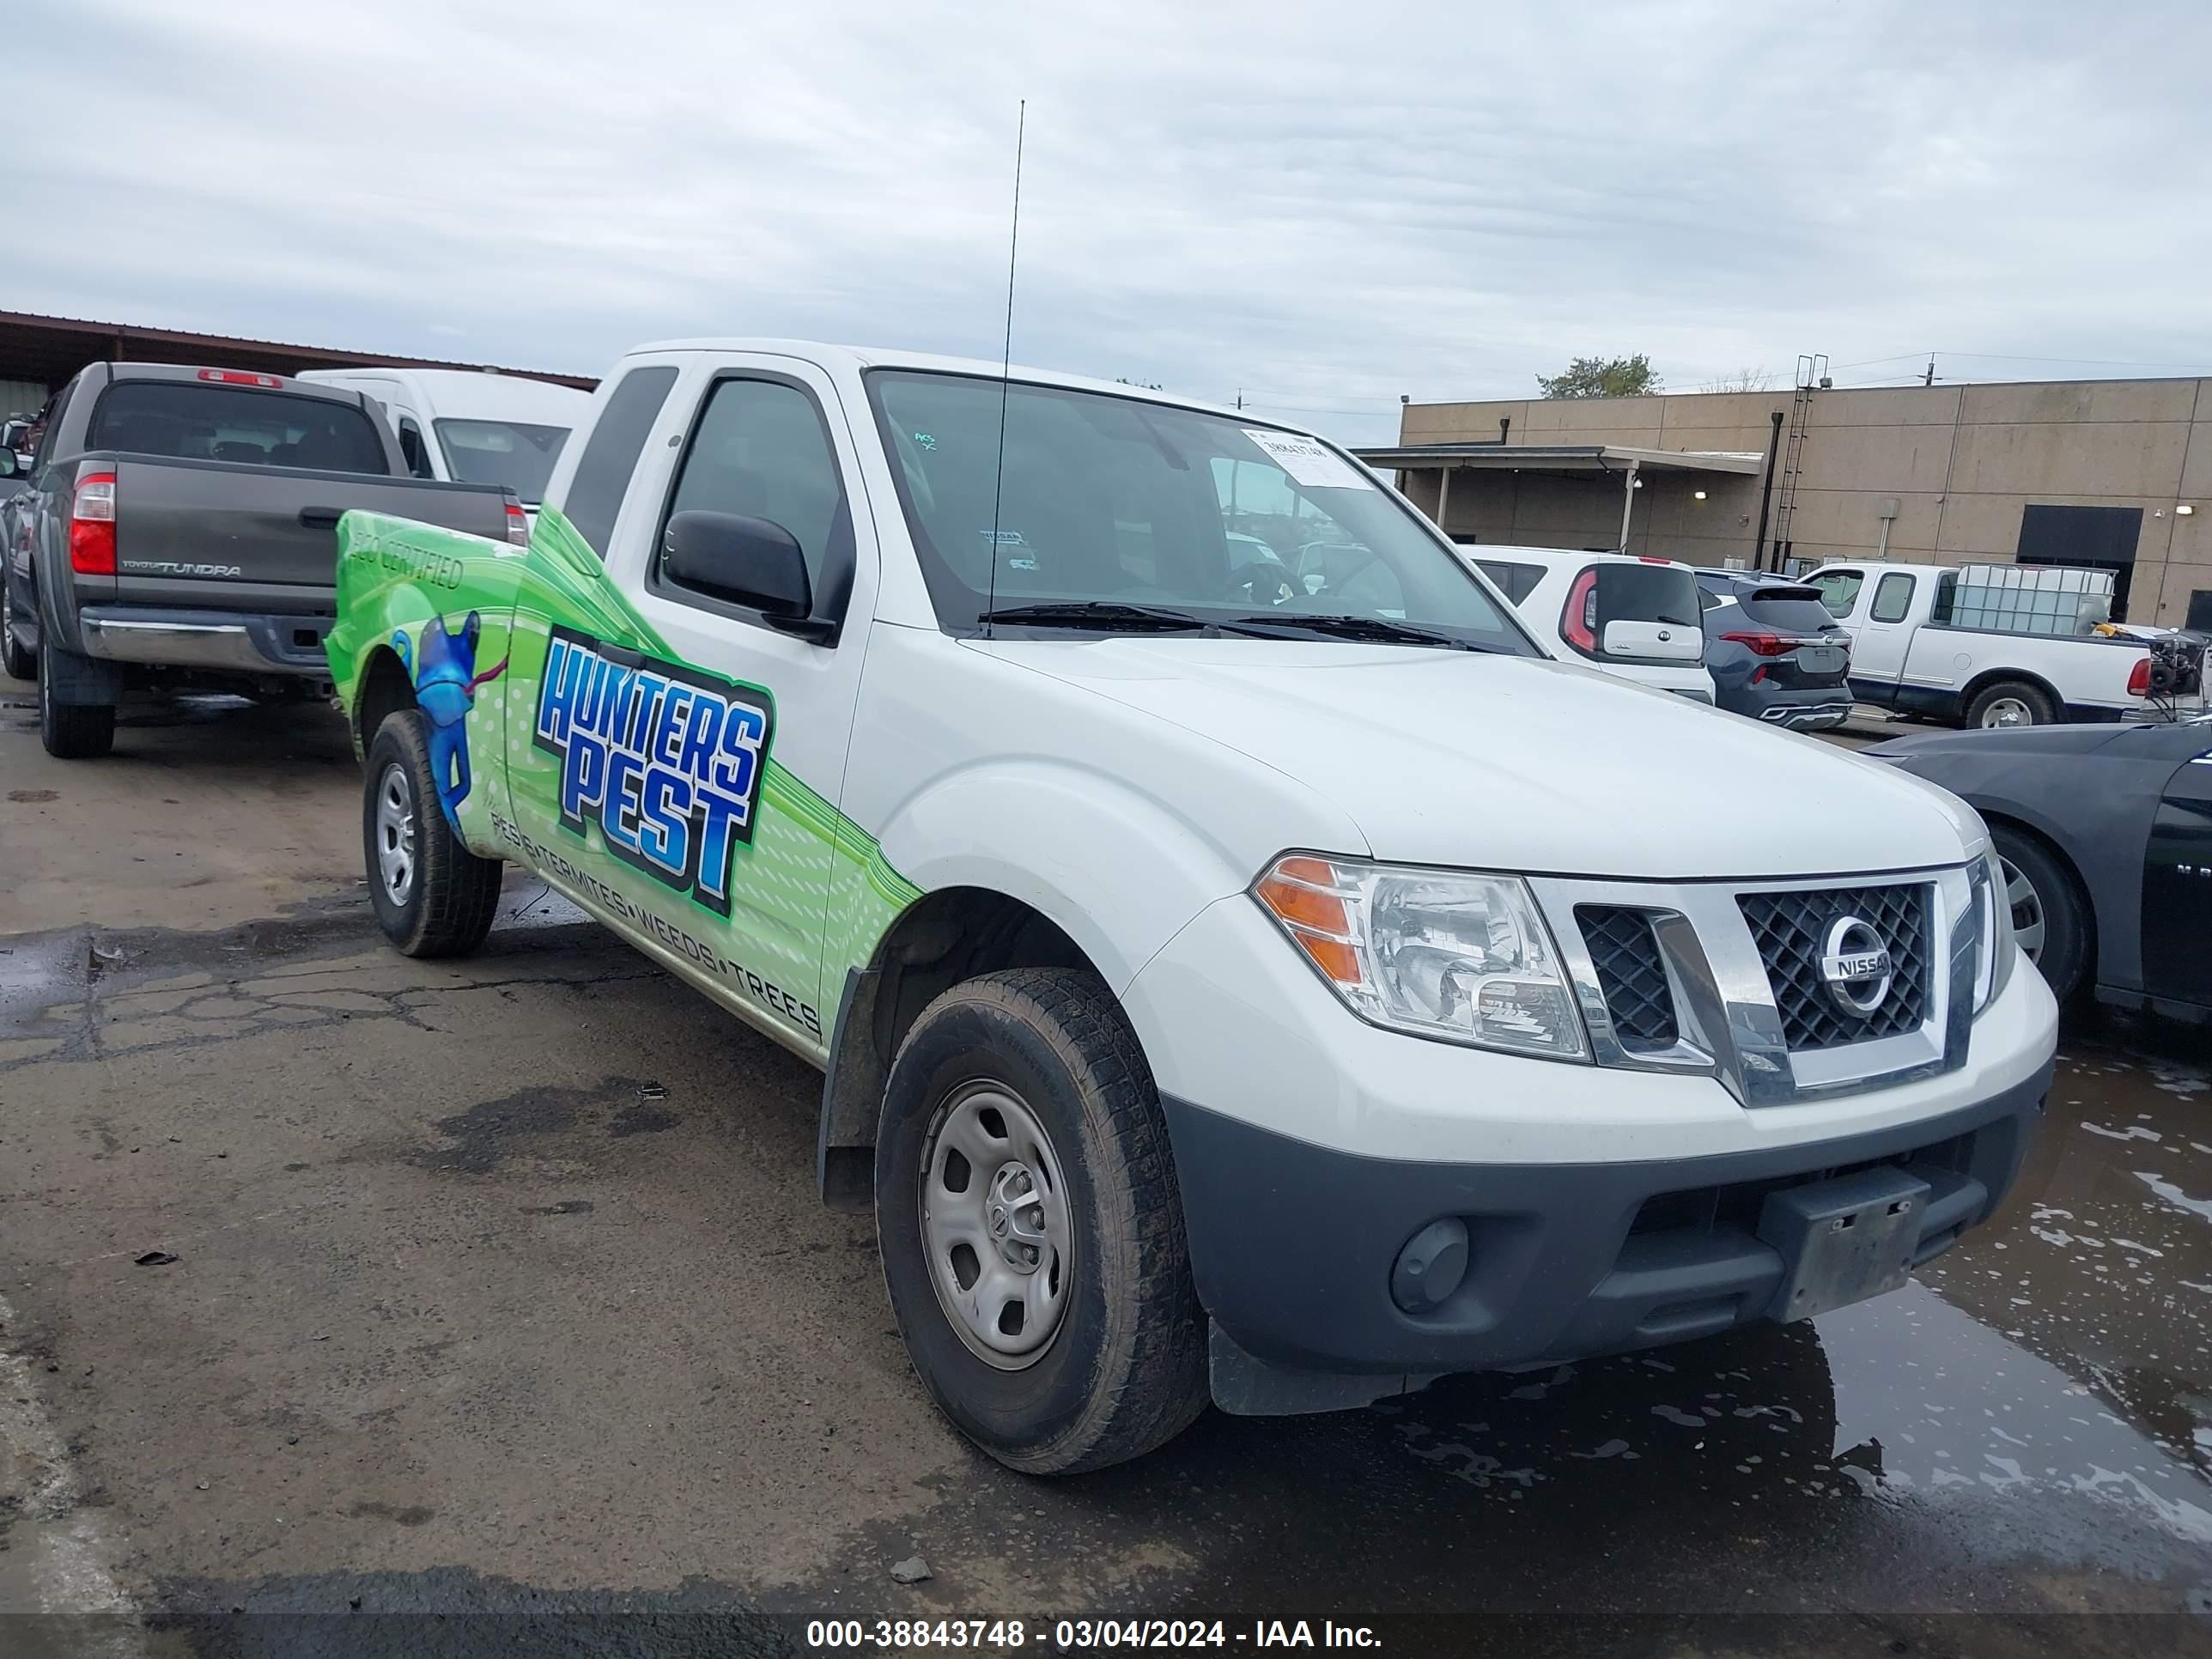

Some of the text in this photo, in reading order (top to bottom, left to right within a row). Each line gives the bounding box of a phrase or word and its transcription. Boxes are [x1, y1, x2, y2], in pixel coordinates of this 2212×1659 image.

[155, 561, 241, 576] TUNDRA
[381, 541, 464, 590] CERTIFIED
[537, 636, 766, 805] HUNTERS
[563, 729, 750, 899] PEST
[634, 904, 718, 973] WEEDS
[727, 960, 823, 1036] TREES
